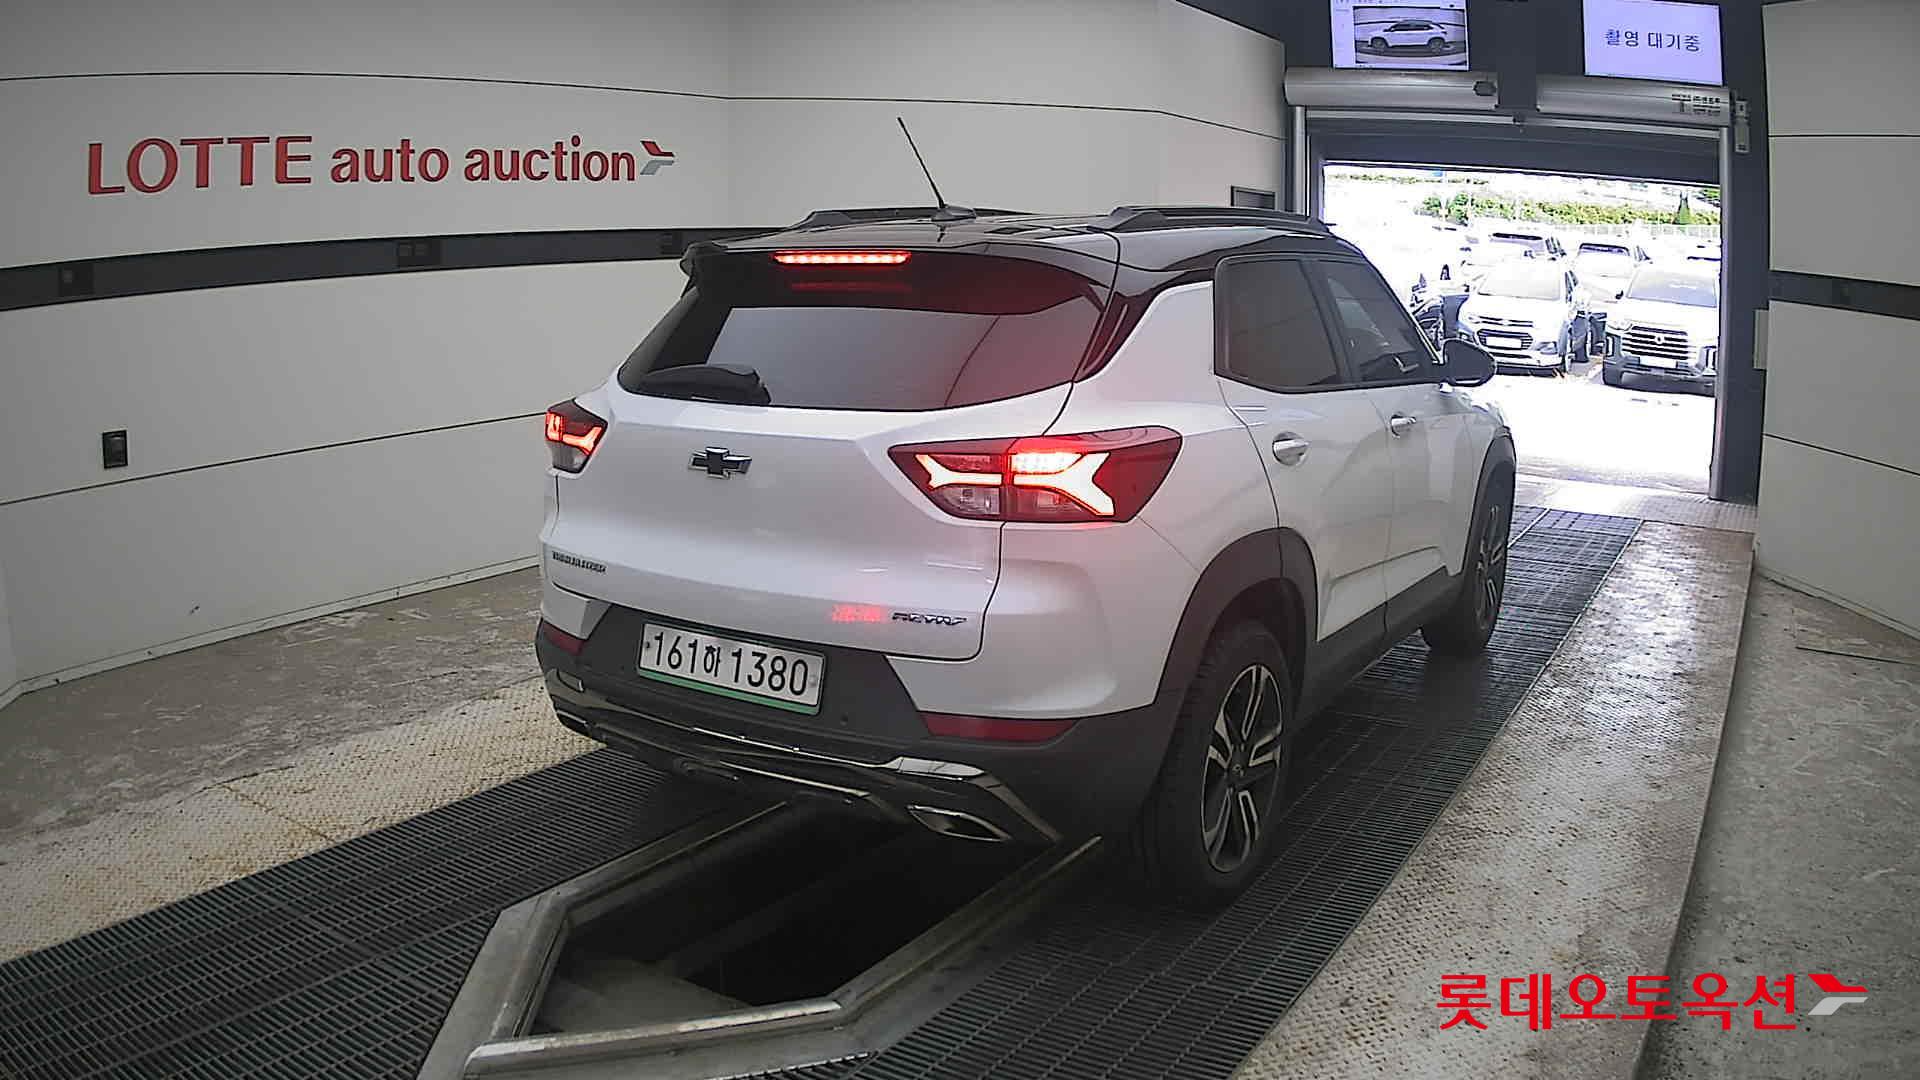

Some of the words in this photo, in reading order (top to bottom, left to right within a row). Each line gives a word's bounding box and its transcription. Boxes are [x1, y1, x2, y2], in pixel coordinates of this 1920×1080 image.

[1647, 32, 1700, 51] 대기중
[88, 135, 312, 194] LOTTE
[330, 138, 449, 183] auto
[463, 135, 635, 181] auction
[654, 631, 721, 677] 161하
[731, 647, 809, 696] 1380
